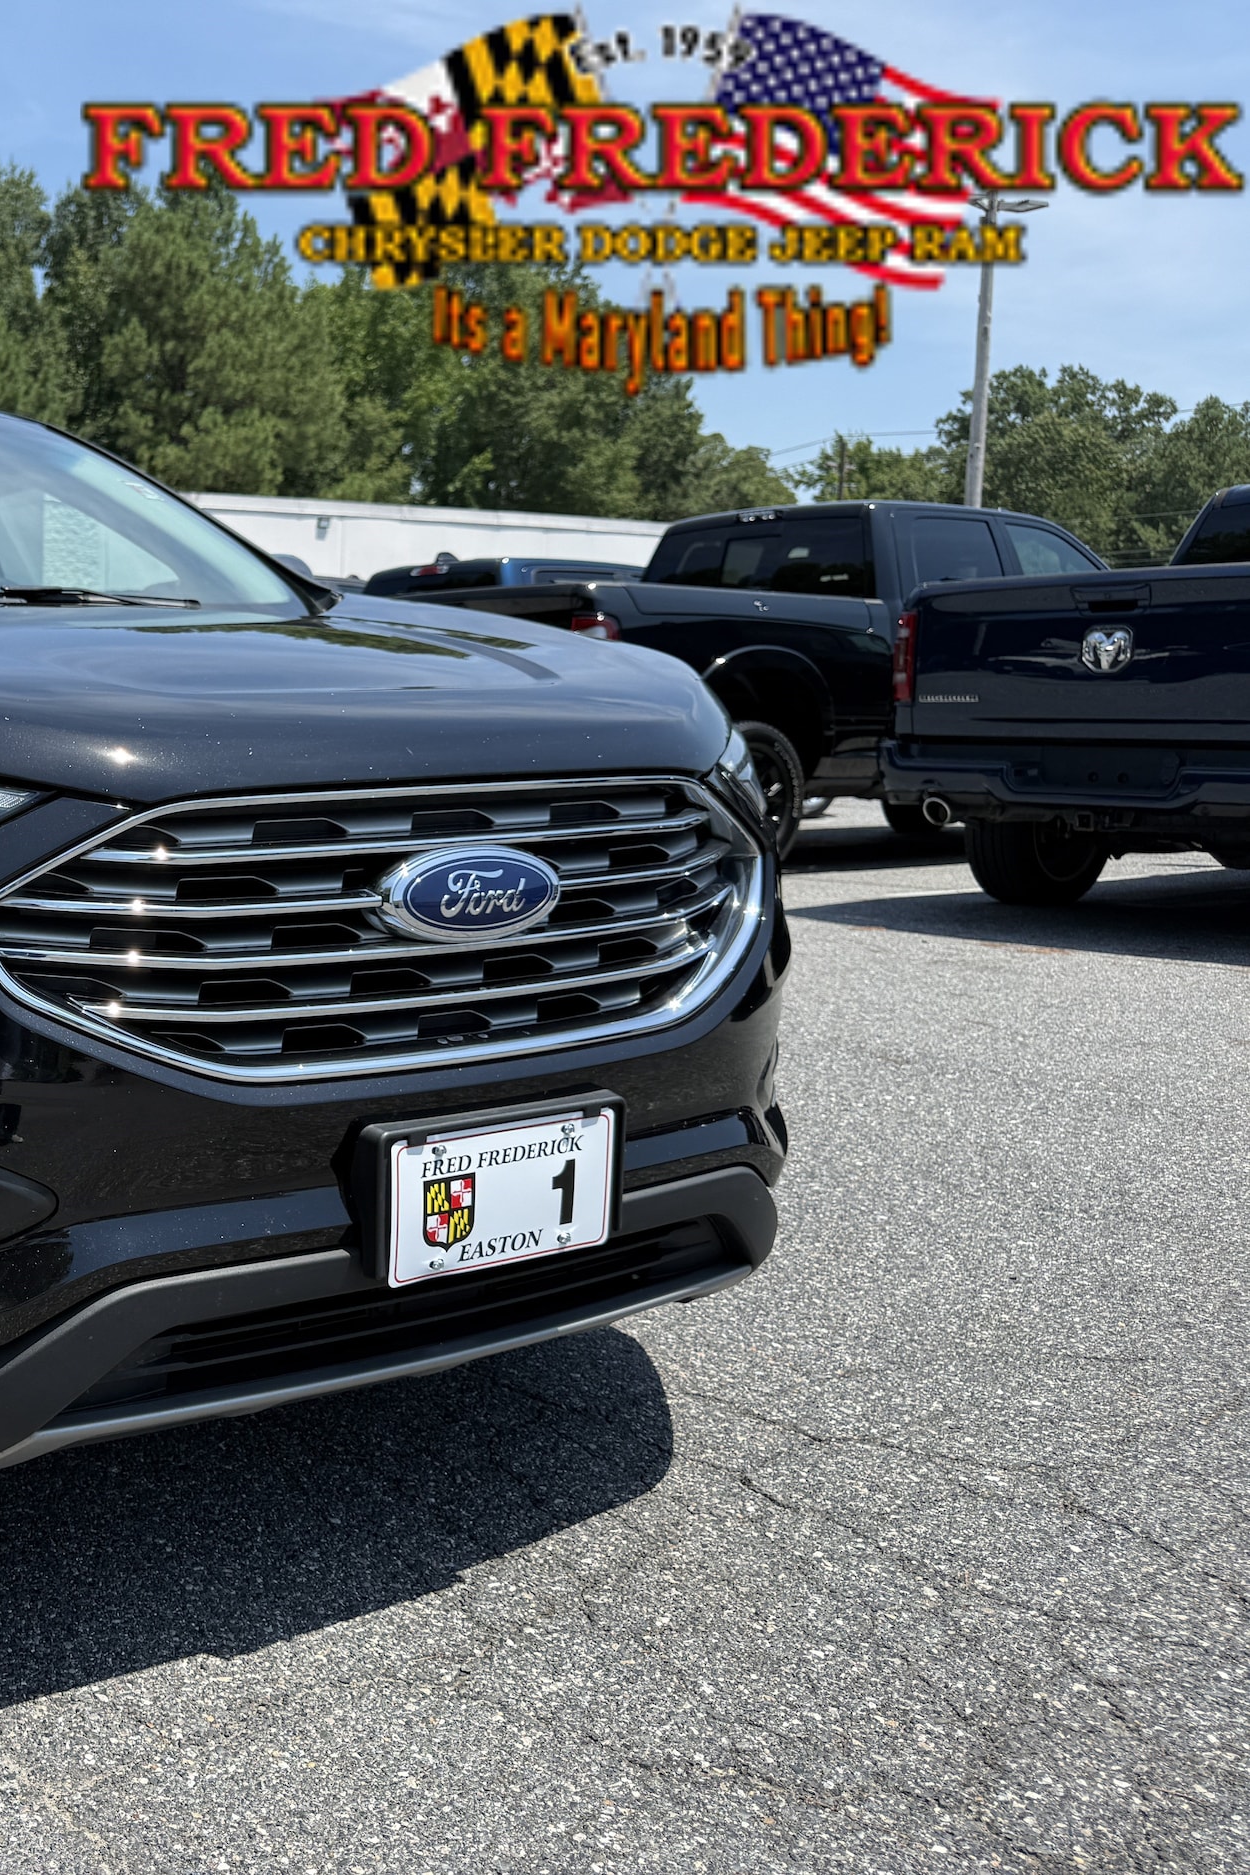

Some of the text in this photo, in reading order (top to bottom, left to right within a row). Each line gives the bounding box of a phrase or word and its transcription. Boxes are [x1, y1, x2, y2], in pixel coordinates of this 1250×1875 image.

[439, 868, 527, 919] Ford
[420, 1134, 585, 1179] FRED FREDERICK
[551, 1157, 577, 1226] 1
[456, 1228, 545, 1264] EASTON
